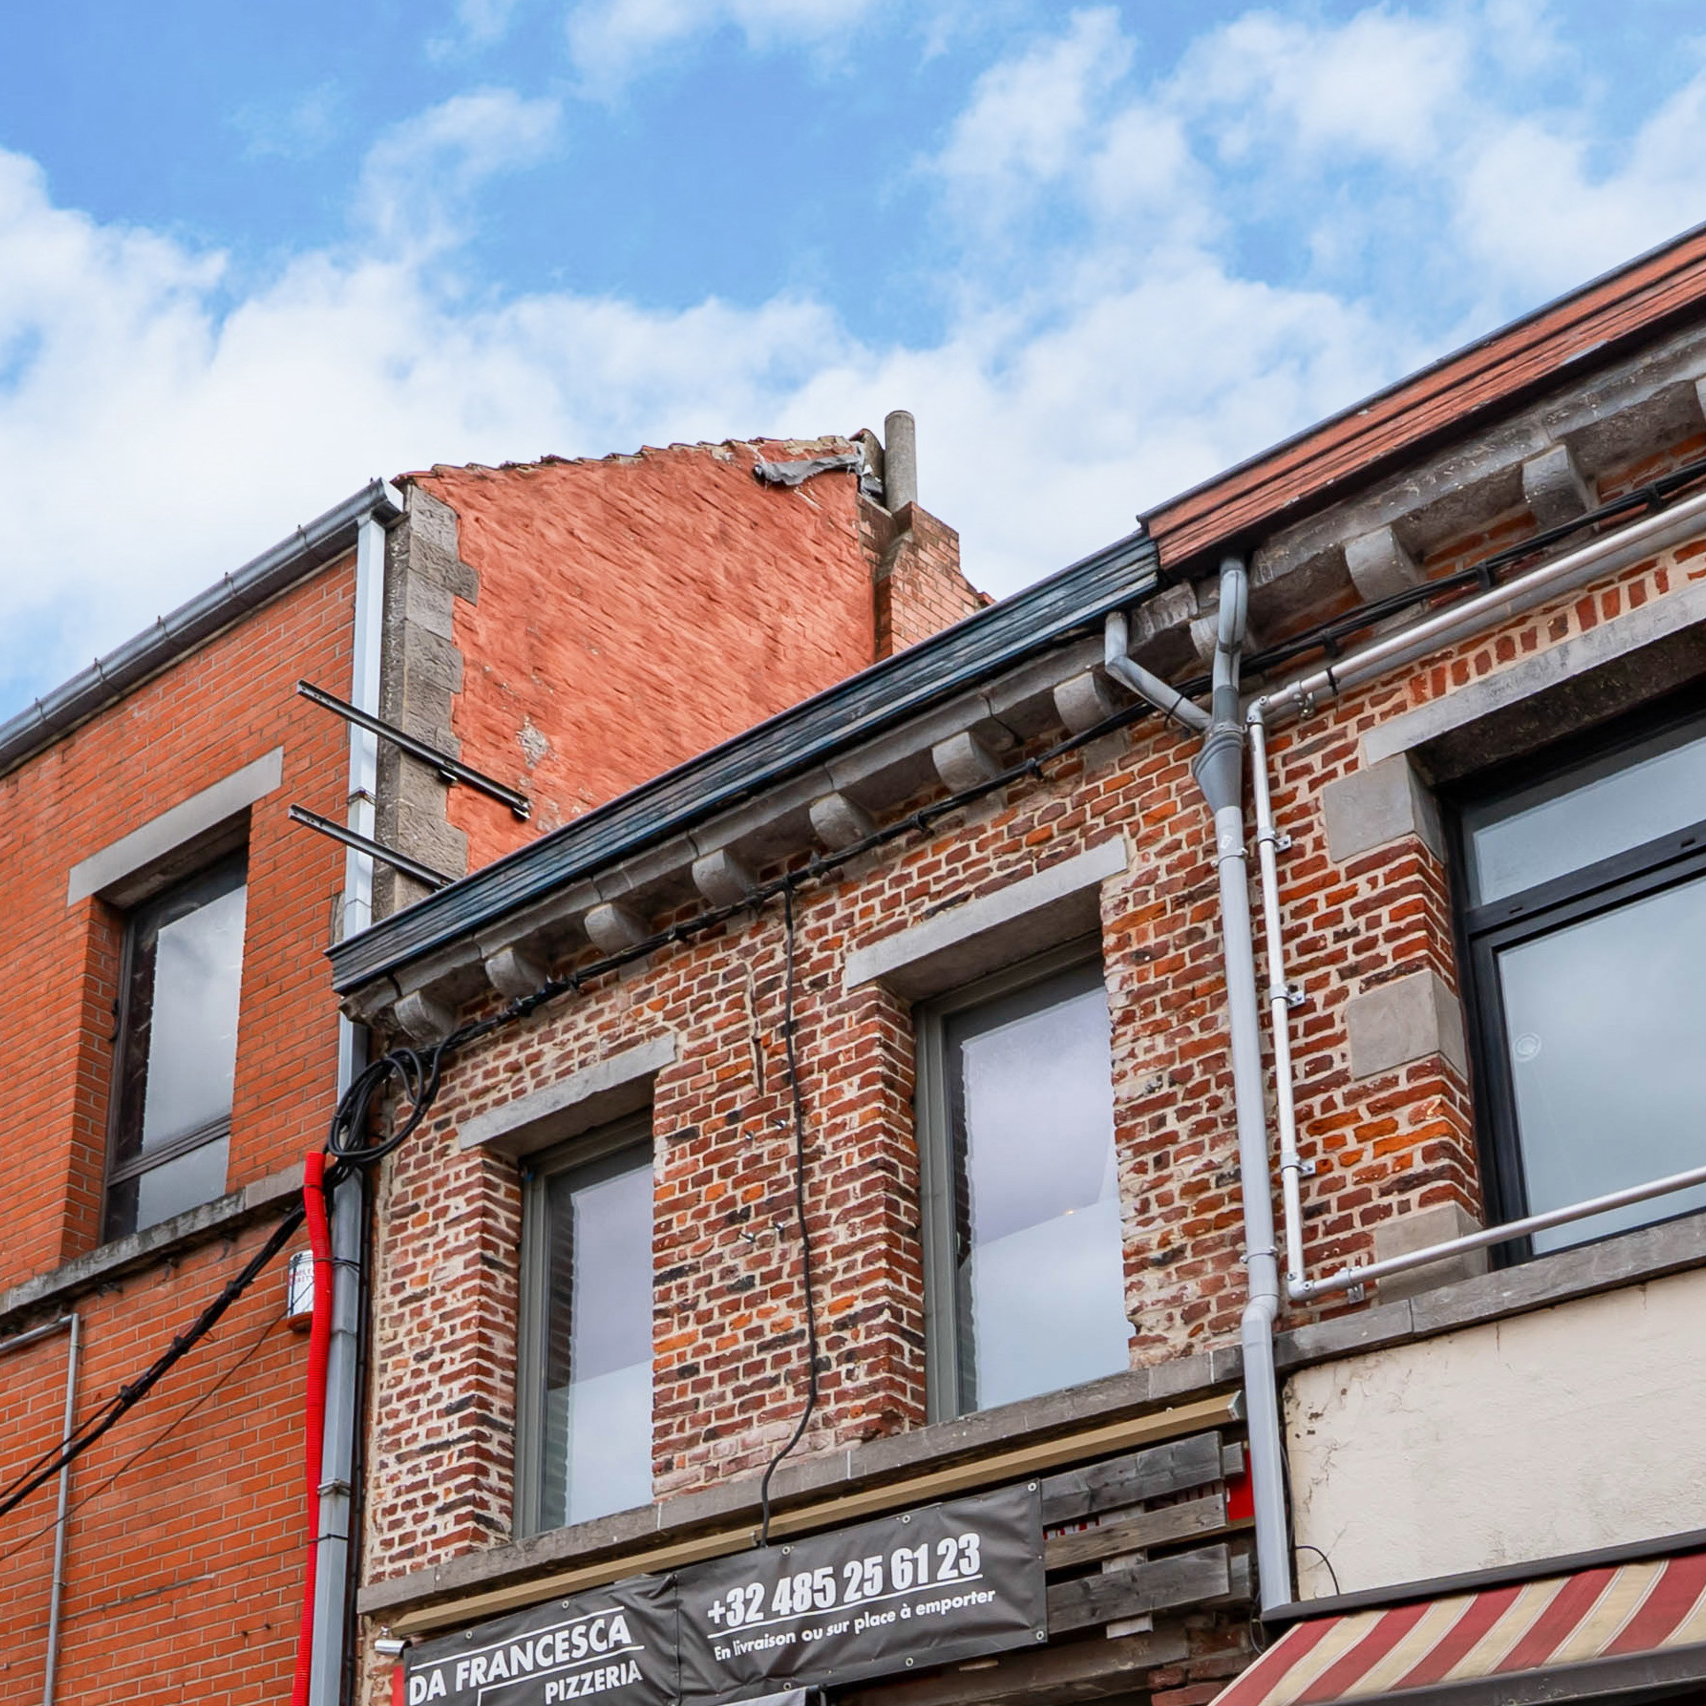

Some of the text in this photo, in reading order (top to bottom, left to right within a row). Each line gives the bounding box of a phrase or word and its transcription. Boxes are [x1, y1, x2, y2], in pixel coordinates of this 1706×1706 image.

[707, 1533, 981, 1628] +32 485 25 61 23
[409, 1615, 632, 1706] DA FRANCESCA
[714, 1590, 996, 1661] En livraison ou sur place à emporter
[545, 1659, 643, 1705] PIZZERIA
